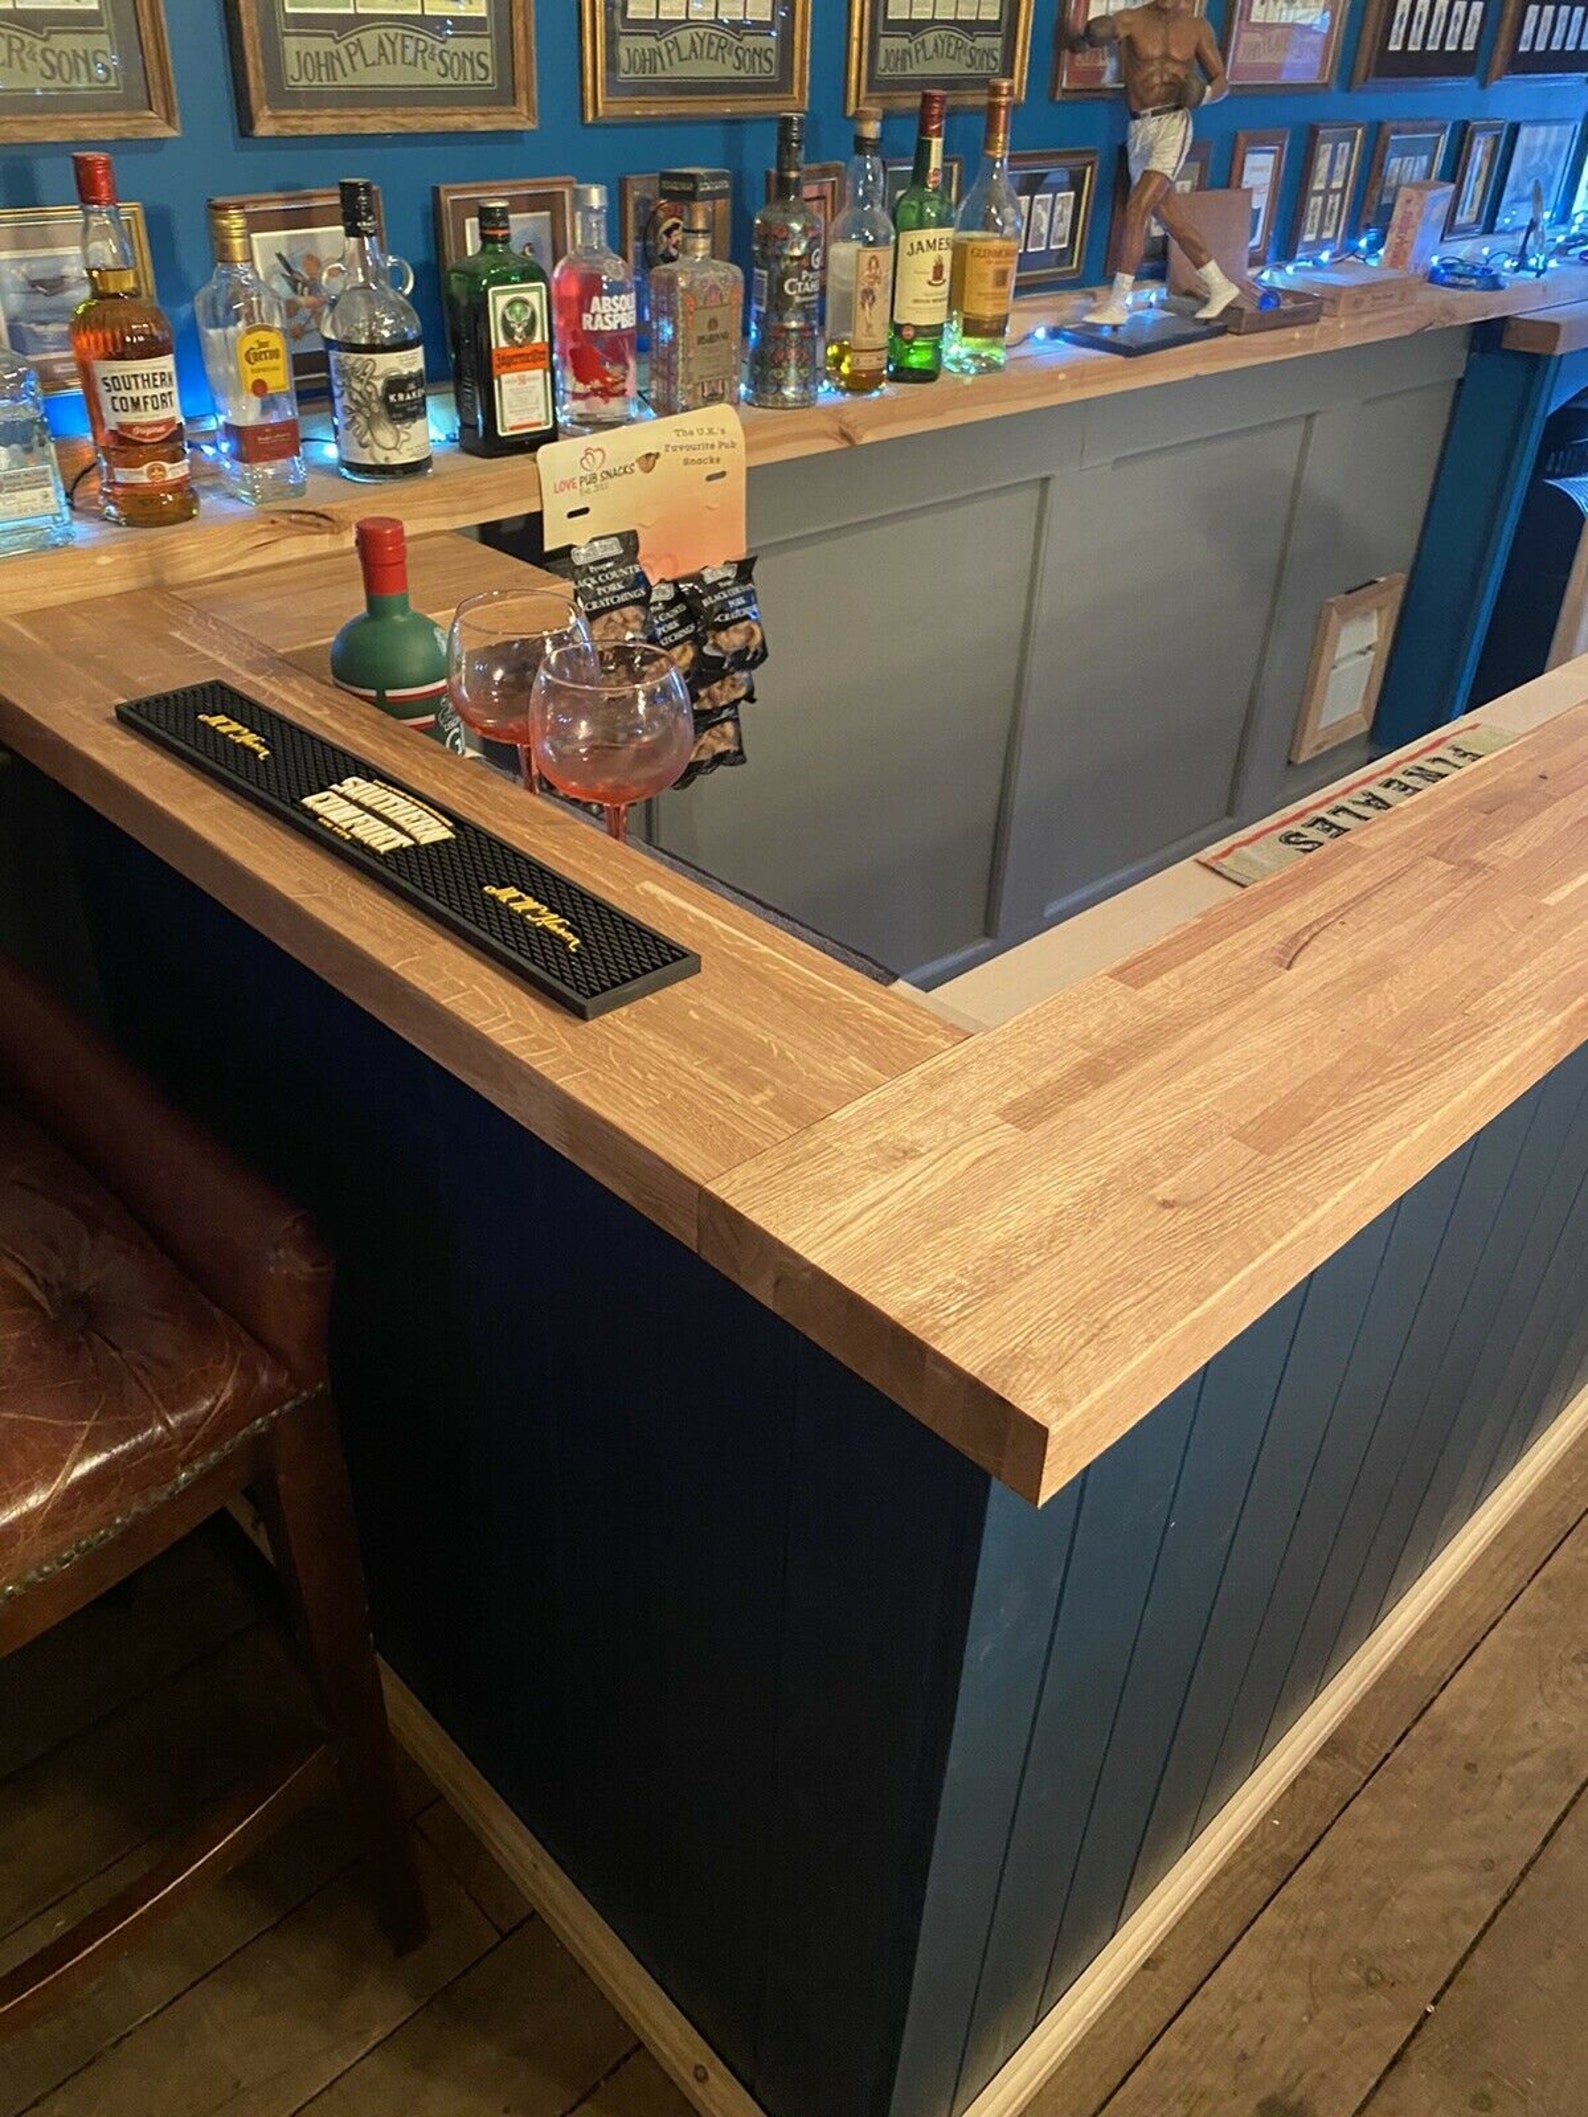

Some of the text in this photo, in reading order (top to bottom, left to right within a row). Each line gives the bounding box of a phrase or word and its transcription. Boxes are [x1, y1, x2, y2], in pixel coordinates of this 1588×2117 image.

[290, 50, 347, 82] JOHN
[344, 32, 429, 73] PLAYER
[437, 48, 490, 81] SONS
[622, 45, 666, 75] JOHN
[664, 31, 729, 67] PLAYER
[732, 46, 774, 74] SONS
[880, 47, 914, 72] JOHN
[913, 33, 964, 64] PLAYER
[965, 46, 999, 71] SONS
[40, 47, 111, 84] SONS
[582, 310, 636, 331] RASPBE
[101, 371, 174, 393] SOUTHERN
[110, 391, 174, 413] COMFORT
[673, 427, 695, 438] The
[664, 439, 738, 454] Favourite Pub
[682, 455, 721, 467] Snacks
[553, 462, 636, 495] LOVE PUB SNACKS
[574, 563, 643, 590] ACK COUNTR
[596, 581, 626, 597] PORK
[701, 591, 728, 607] BLACK
[656, 619, 680, 635] PORK
[328, 776, 456, 846] SOUTHERN
[1278, 745, 1485, 856] FINE ALES
[301, 790, 415, 854] COMFORT
